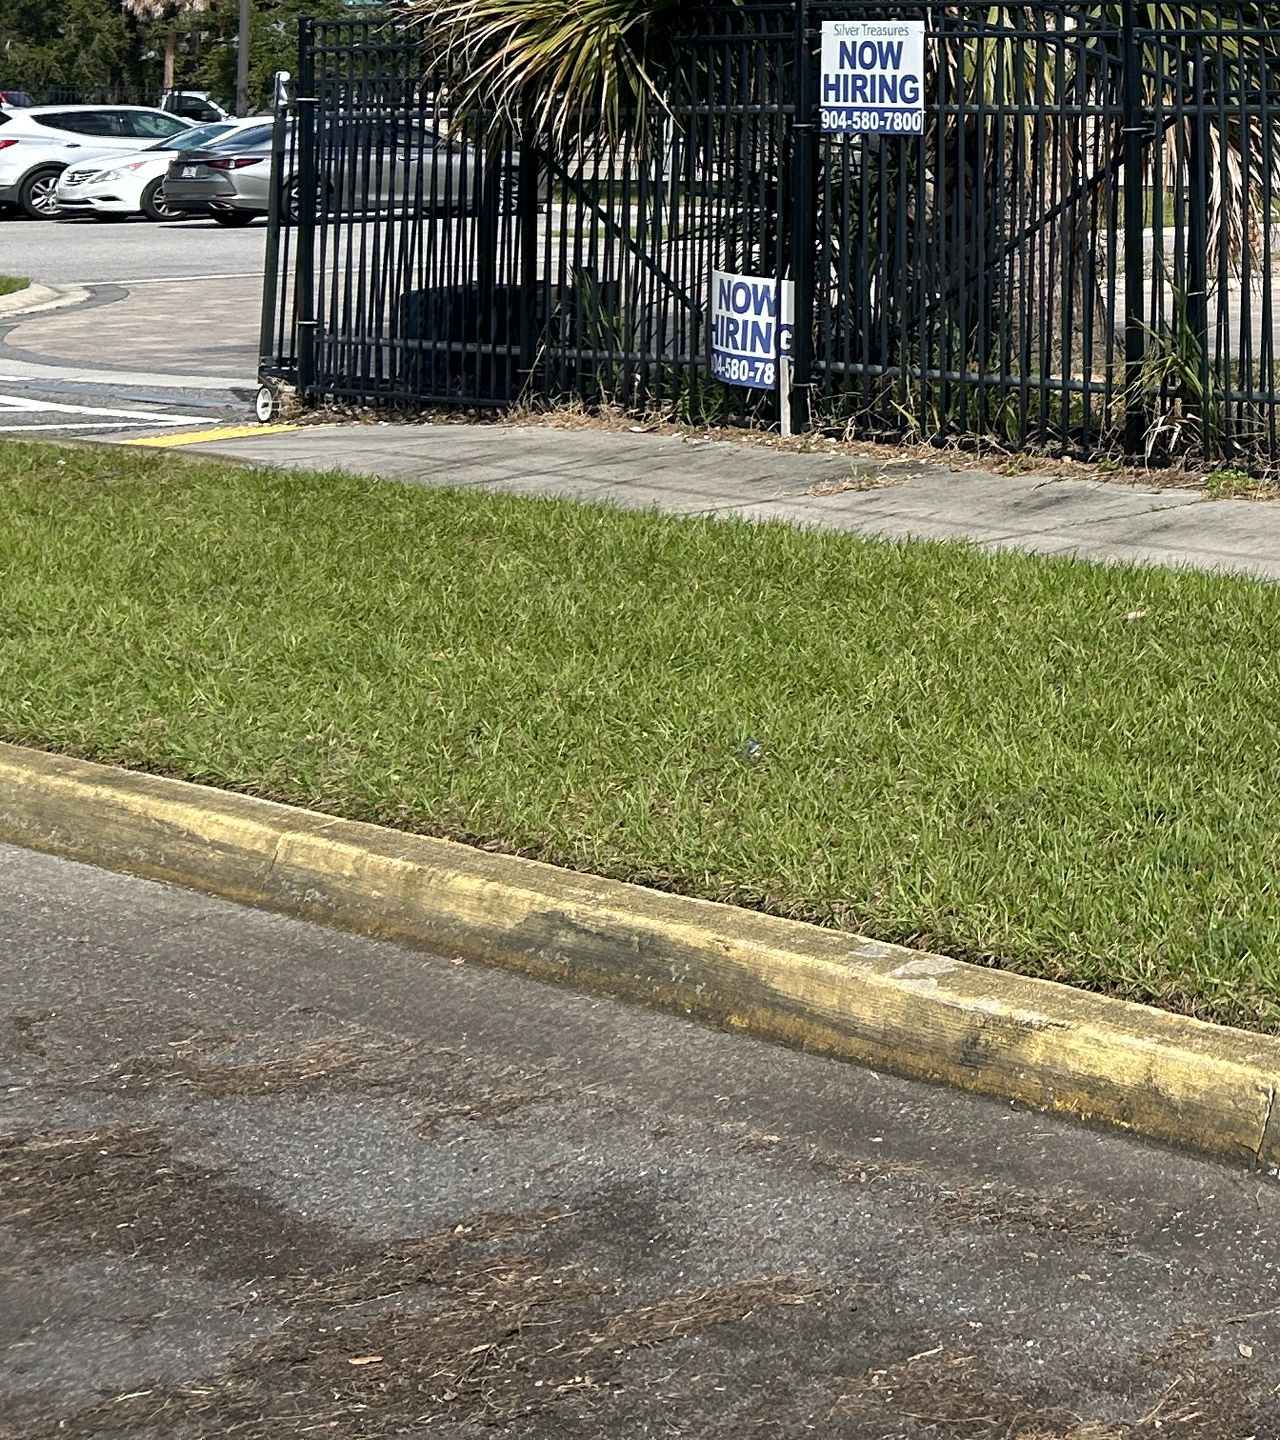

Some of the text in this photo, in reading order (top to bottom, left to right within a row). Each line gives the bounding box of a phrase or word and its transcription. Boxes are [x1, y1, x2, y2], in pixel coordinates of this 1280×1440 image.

[833, 23, 909, 37] Silver Treasures
[838, 40, 904, 71] NOW
[822, 73, 920, 104] HIRING
[821, 110, 922, 131] 904-580-7800
